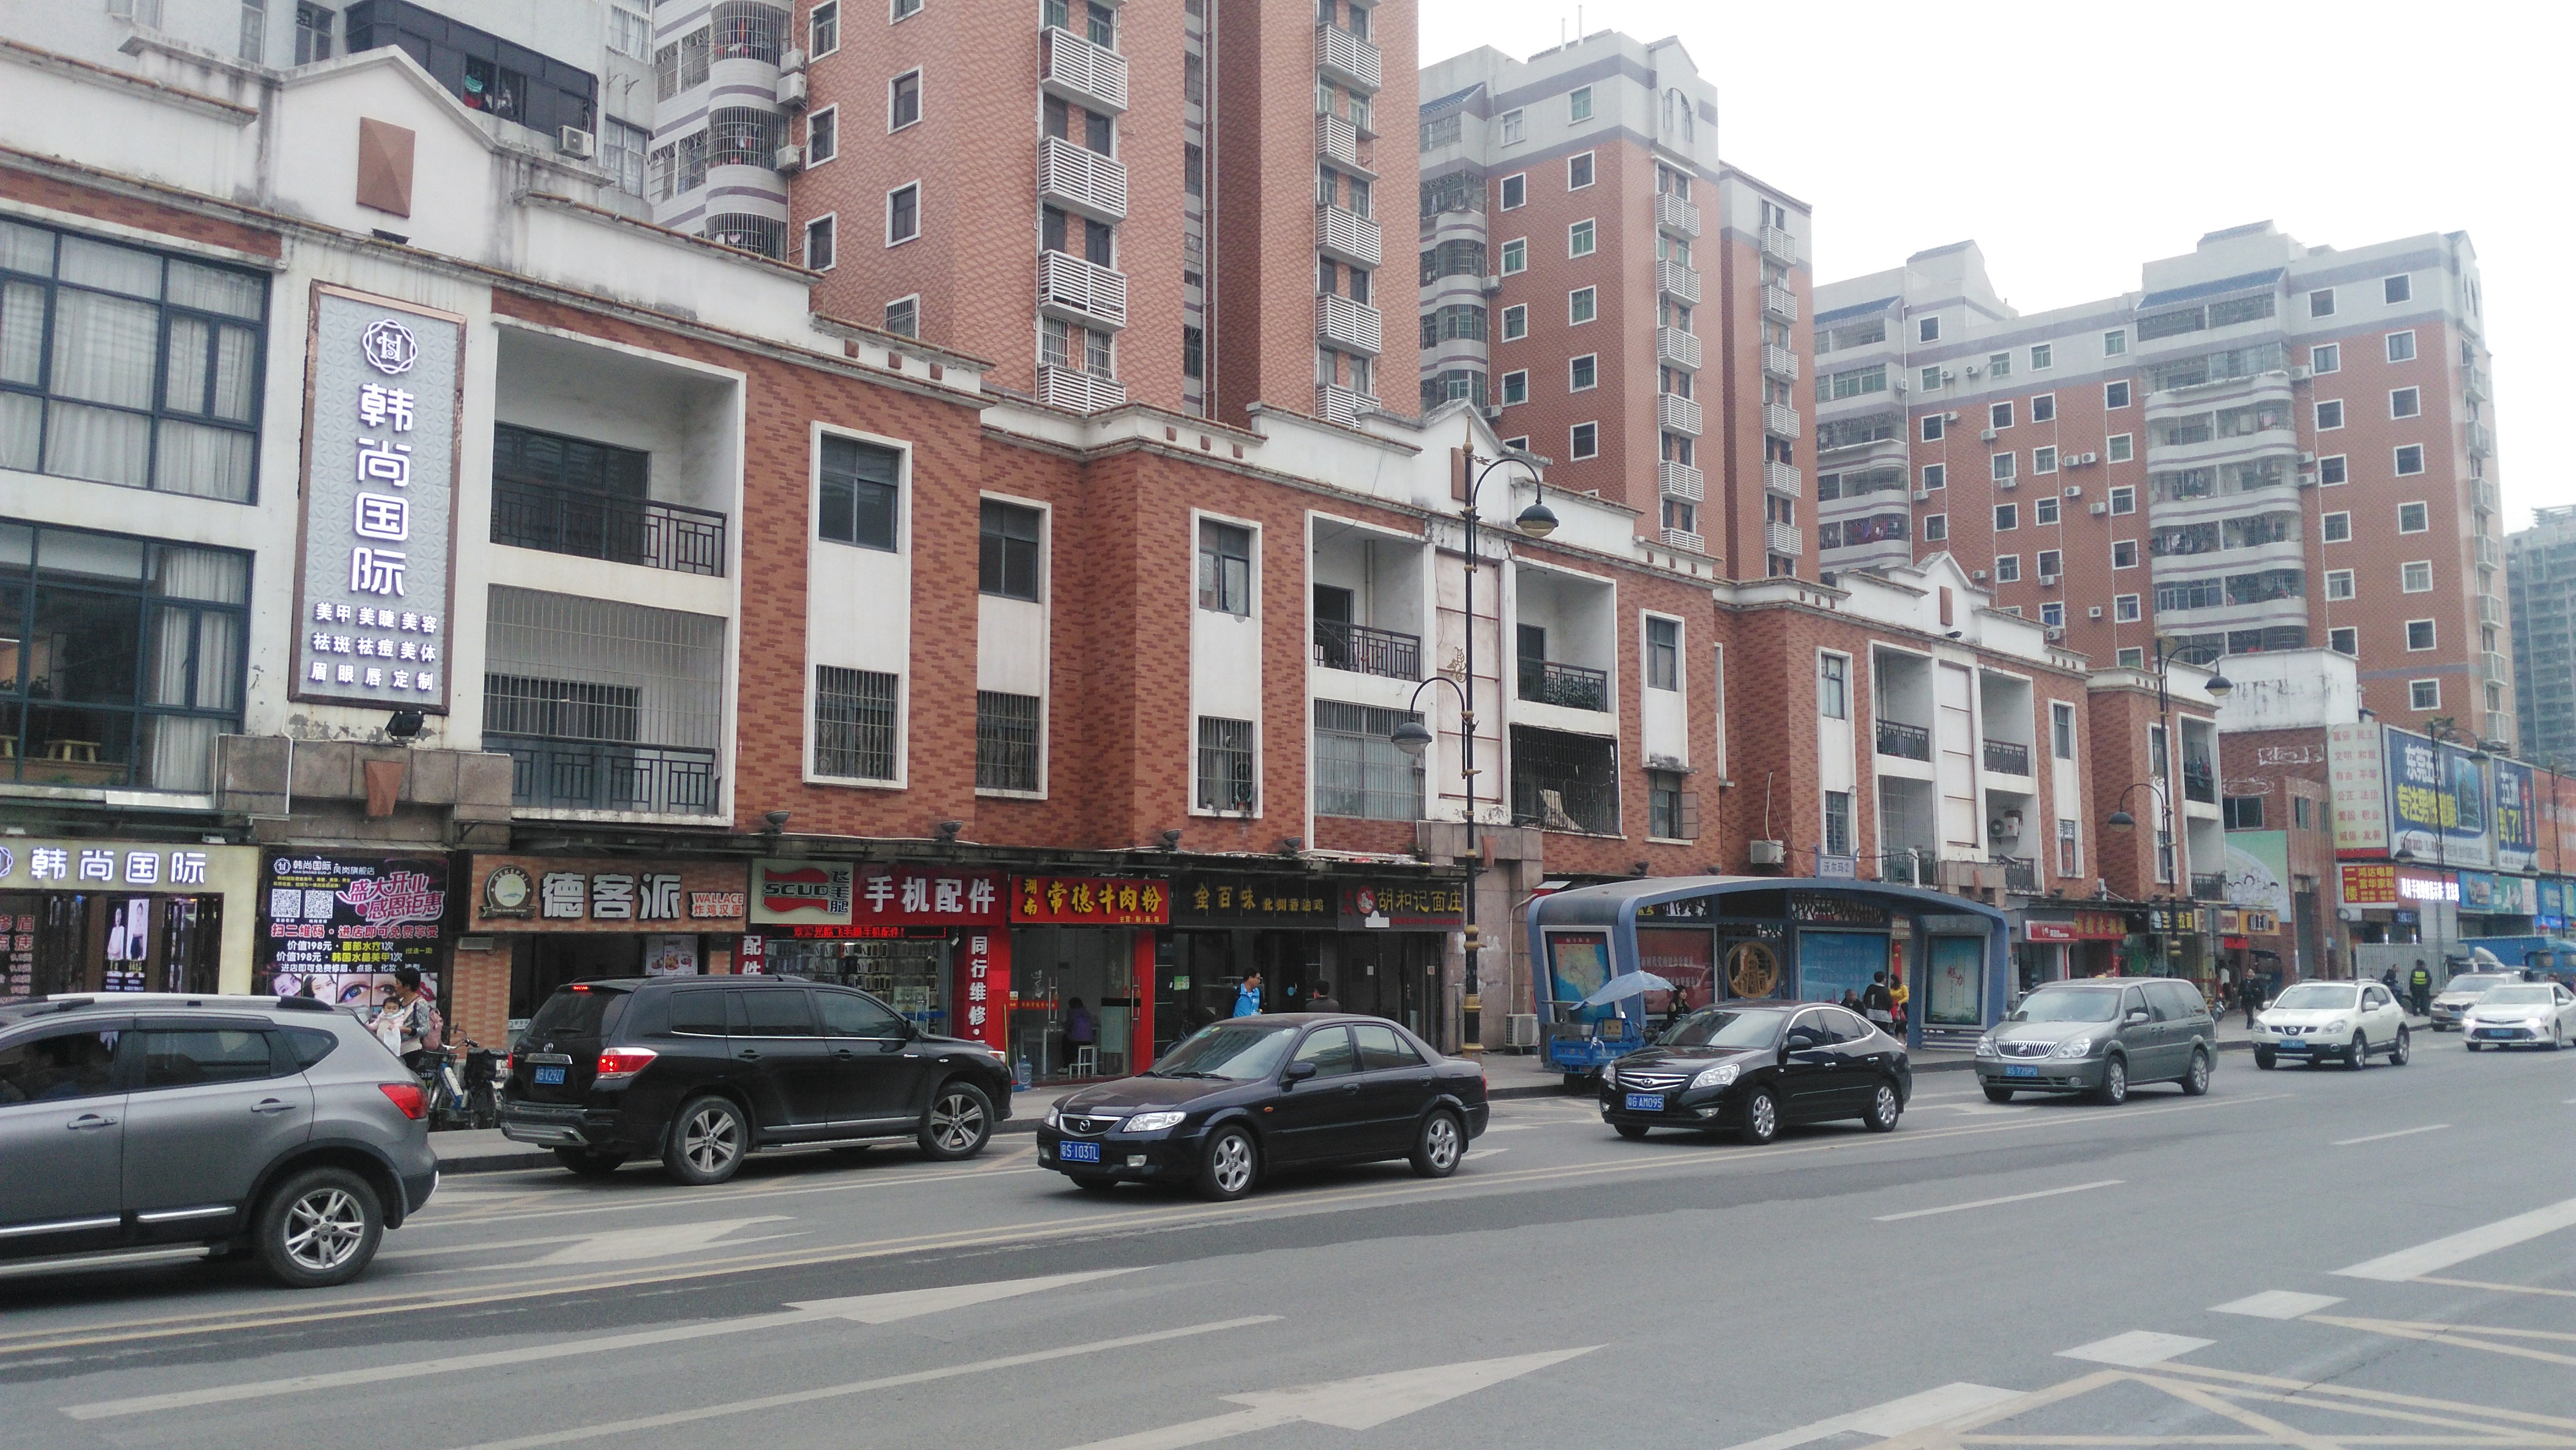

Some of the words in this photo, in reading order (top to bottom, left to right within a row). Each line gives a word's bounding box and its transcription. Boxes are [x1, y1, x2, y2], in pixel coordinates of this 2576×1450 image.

[351, 382, 414, 597] 韩尚国际
[316, 602, 351, 621] 美甲
[359, 607, 395, 628] 美睫
[402, 612, 438, 633] 美容
[313, 633, 351, 654] 祛斑
[357, 637, 395, 658] 祛痘
[399, 642, 436, 663] 美体
[310, 662, 434, 691] 眉眼唇定制
[31, 848, 208, 884] 韩尚国际
[293, 860, 331, 870] 韩尚国际
[333, 865, 375, 876] 凤岗旗舰店
[495, 869, 528, 882] DEKEPAI
[349, 871, 430, 903] 盛大开业
[542, 872, 681, 918] 德客派
[695, 894, 743, 904] WALLACE
[764, 883, 828, 895] SCUD
[829, 870, 850, 914] 飞毛腿
[864, 875, 996, 914] 手机配件
[1024, 878, 1037, 915] 湖南
[1047, 880, 1163, 914] 常德牛肉粉
[1377, 887, 1463, 912] 胡和记面庄
[694, 904, 742, 915] 炸鸡汉堡
[742, 934, 762, 975] 配件
[968, 936, 987, 1043] 同行维修·
